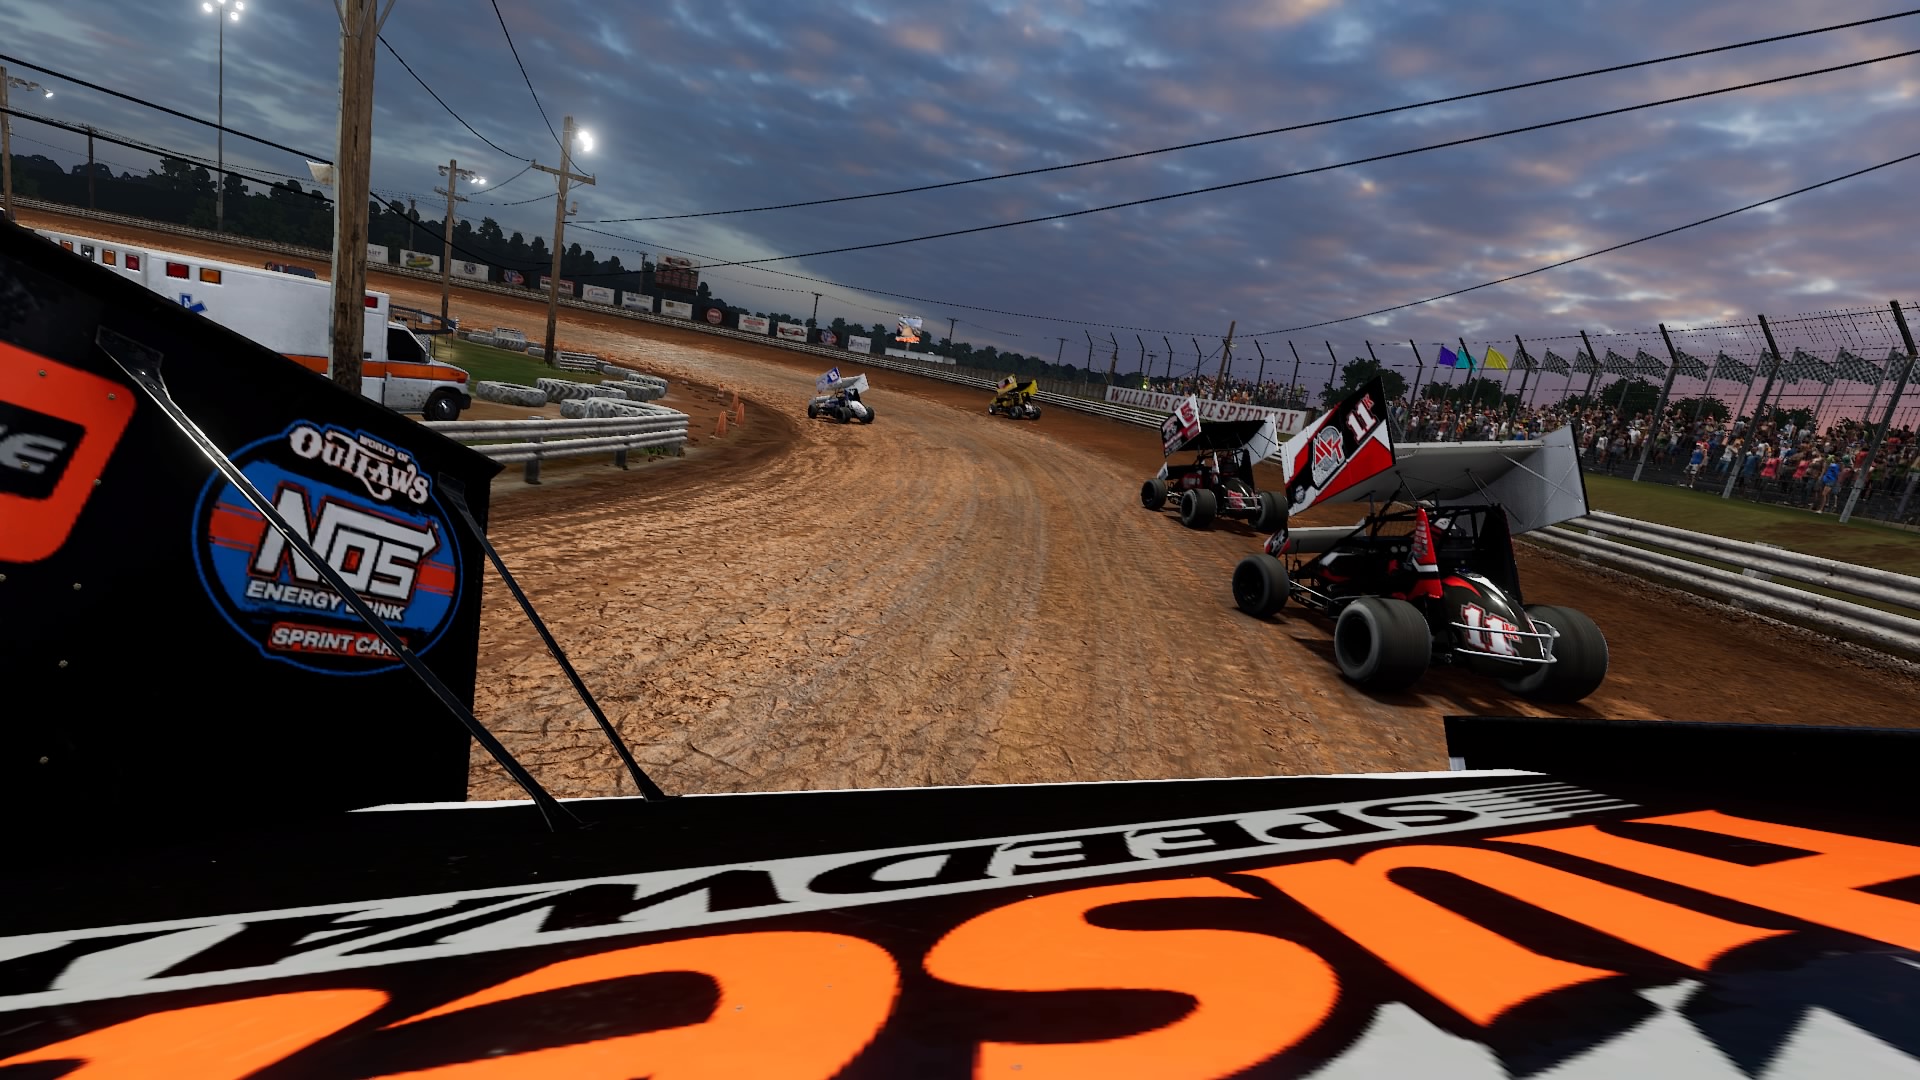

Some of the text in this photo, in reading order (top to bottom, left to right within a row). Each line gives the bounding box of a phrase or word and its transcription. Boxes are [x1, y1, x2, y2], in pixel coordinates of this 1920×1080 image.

[1110, 388, 1169, 412] WILLIAMS
[1171, 400, 1218, 418] GVE
[359, 435, 411, 463] WORLD OF
[254, 487, 438, 601] NOS
[246, 580, 347, 611] ENERGY
[271, 628, 403, 655] SPRINT CAR
